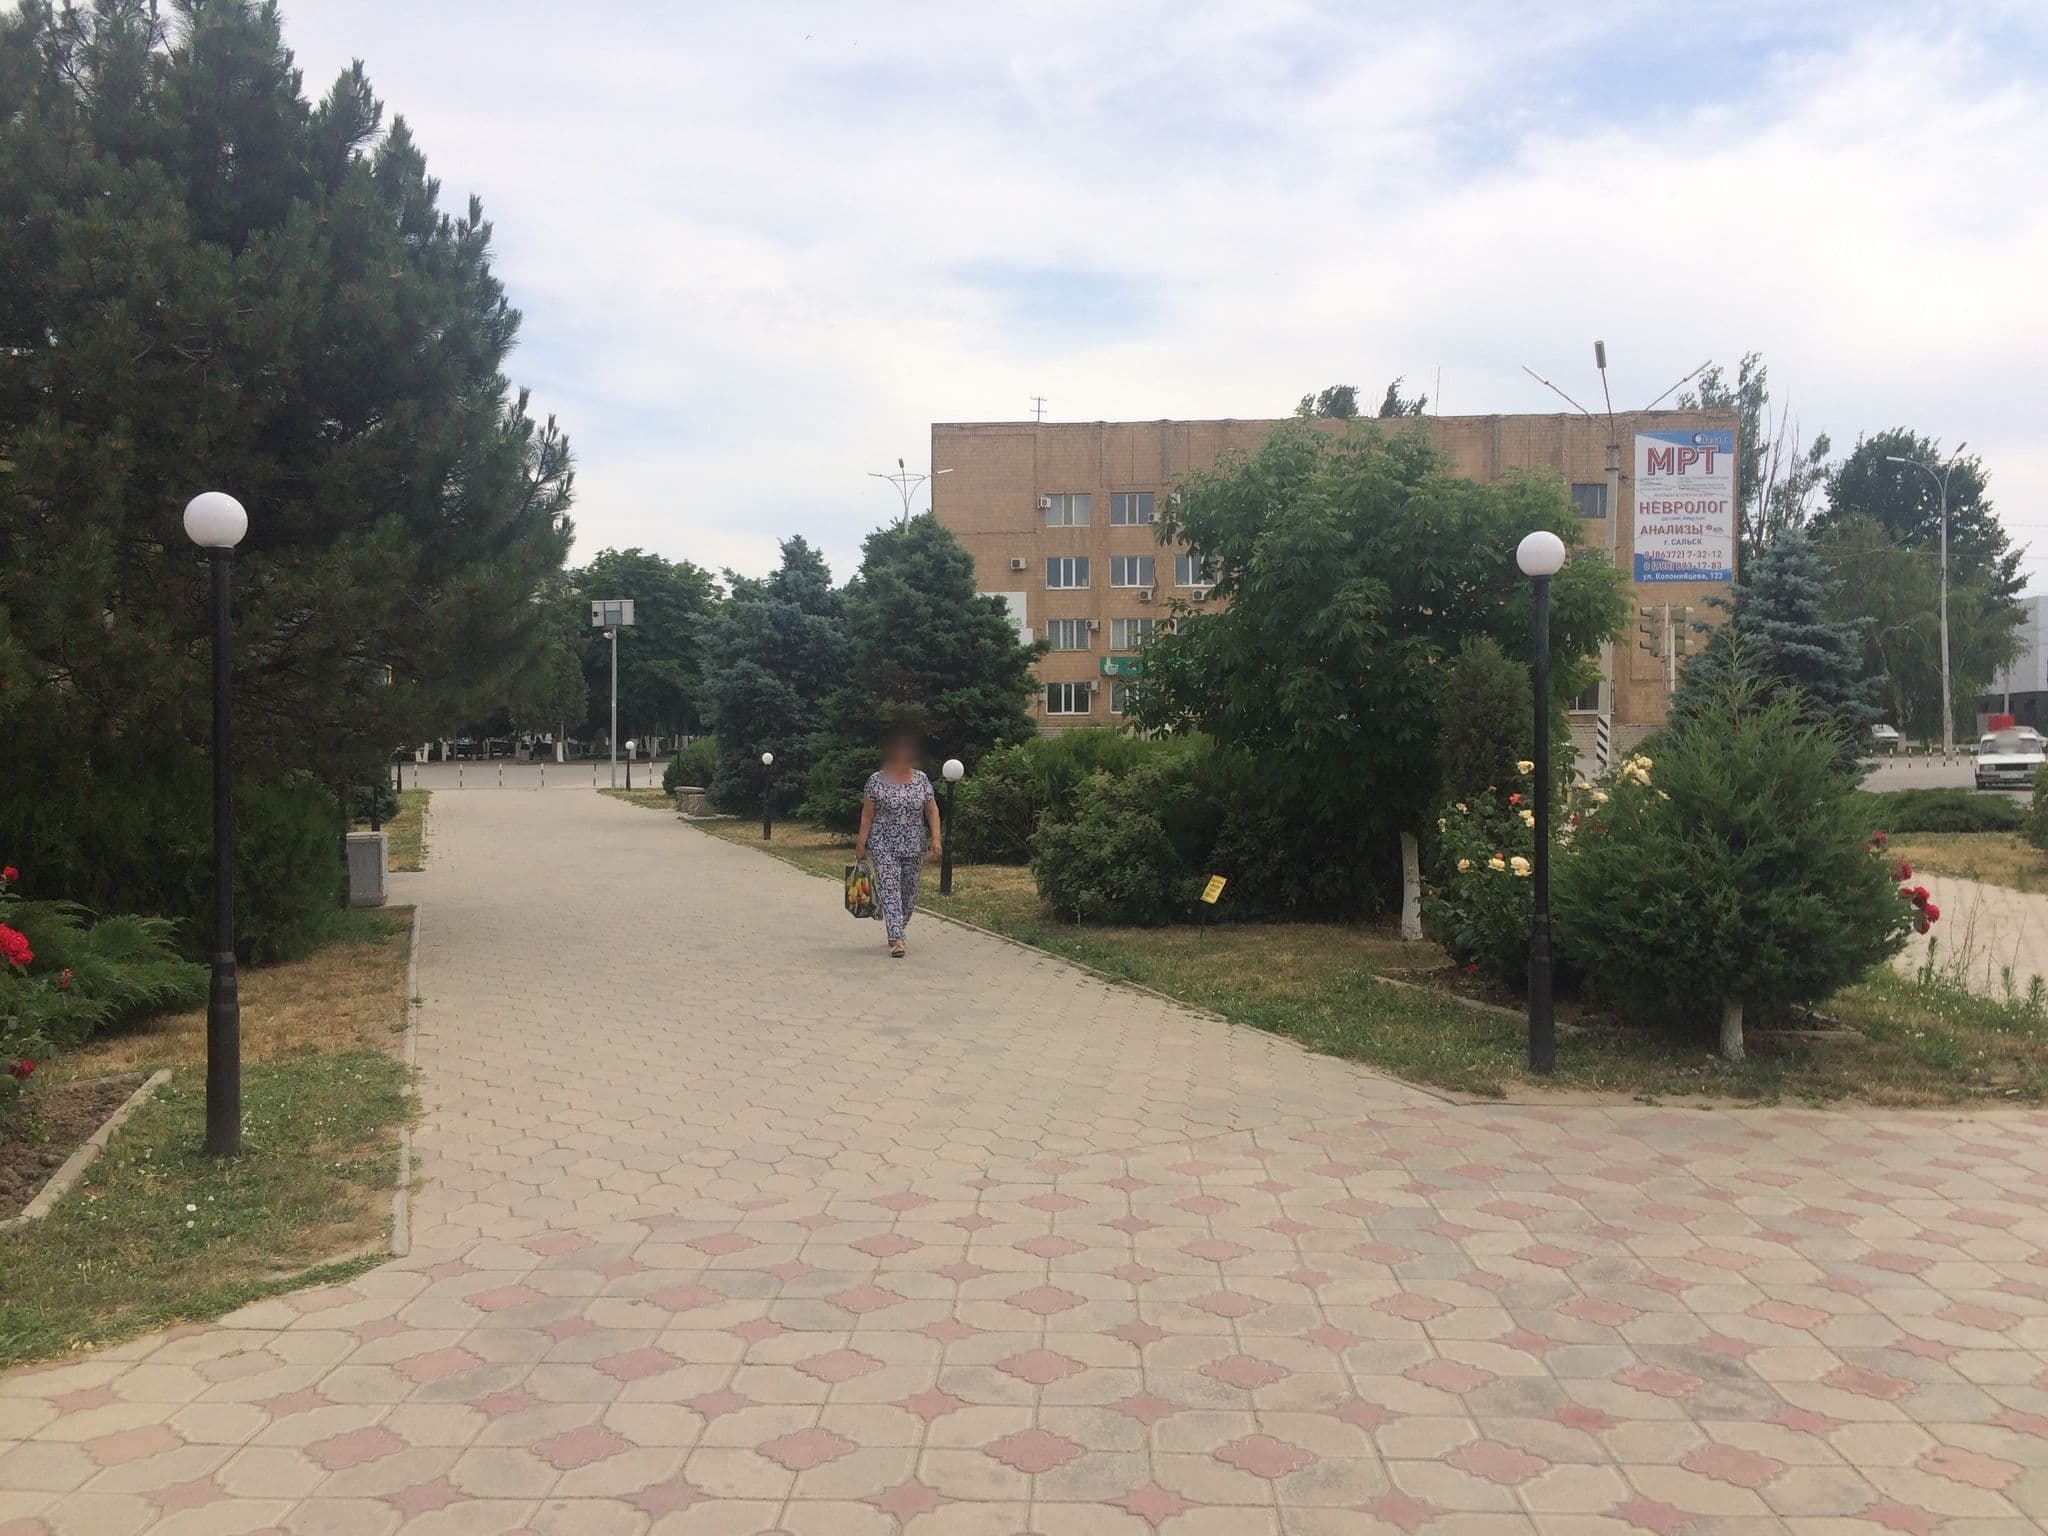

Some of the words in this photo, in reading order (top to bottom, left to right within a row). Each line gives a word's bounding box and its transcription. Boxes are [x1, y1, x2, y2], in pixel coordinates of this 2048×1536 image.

[1647, 445, 1720, 475] МРТ
[1639, 500, 1729, 514] НЕВРОЛОГ
[1640, 524, 1703, 535] АНАЛИЗЫ
[1671, 538, 1703, 546] САЛЬСК
[1644, 551, 1649, 559] 8
[1686, 550, 1723, 559] 7-32-12
